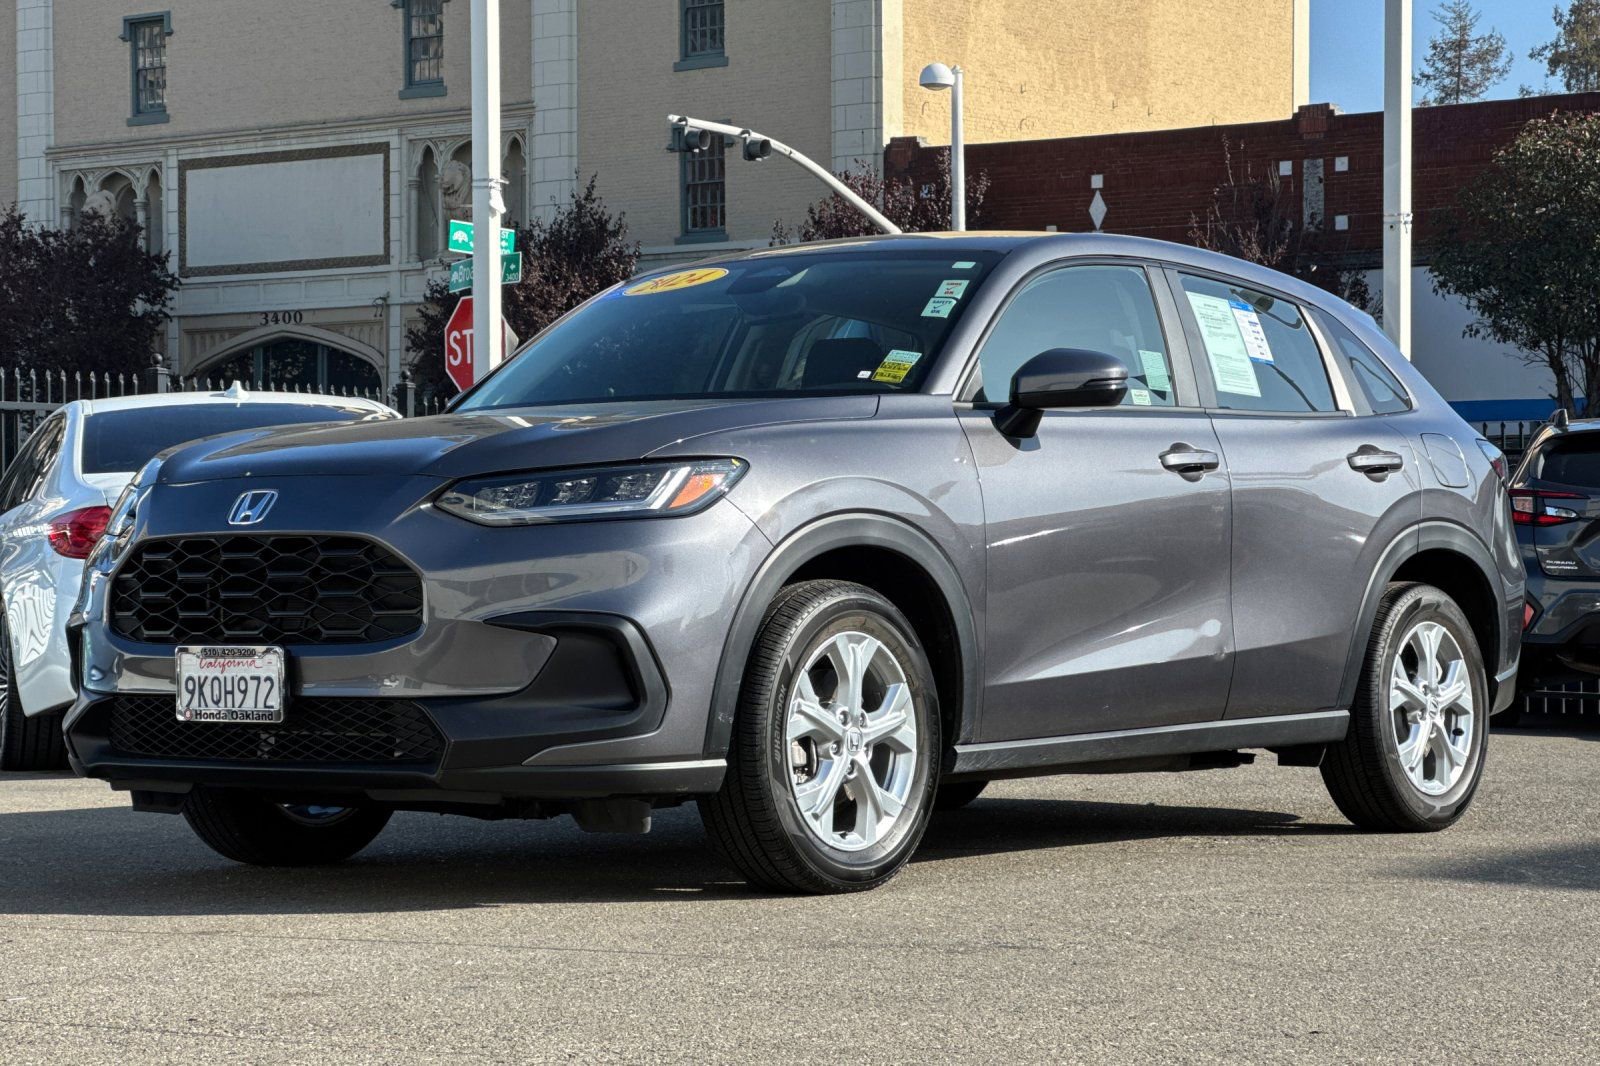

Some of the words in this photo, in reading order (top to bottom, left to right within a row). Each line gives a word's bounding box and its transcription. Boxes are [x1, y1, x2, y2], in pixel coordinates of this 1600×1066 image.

[259, 310, 303, 326] 3400
[449, 329, 474, 367] ST
[222, 648, 257, 656] 420-9200
[199, 658, 263, 674] California
[184, 675, 275, 709] 9KQH972
[195, 710, 227, 720] Honda
[231, 710, 274, 721] Oakland
